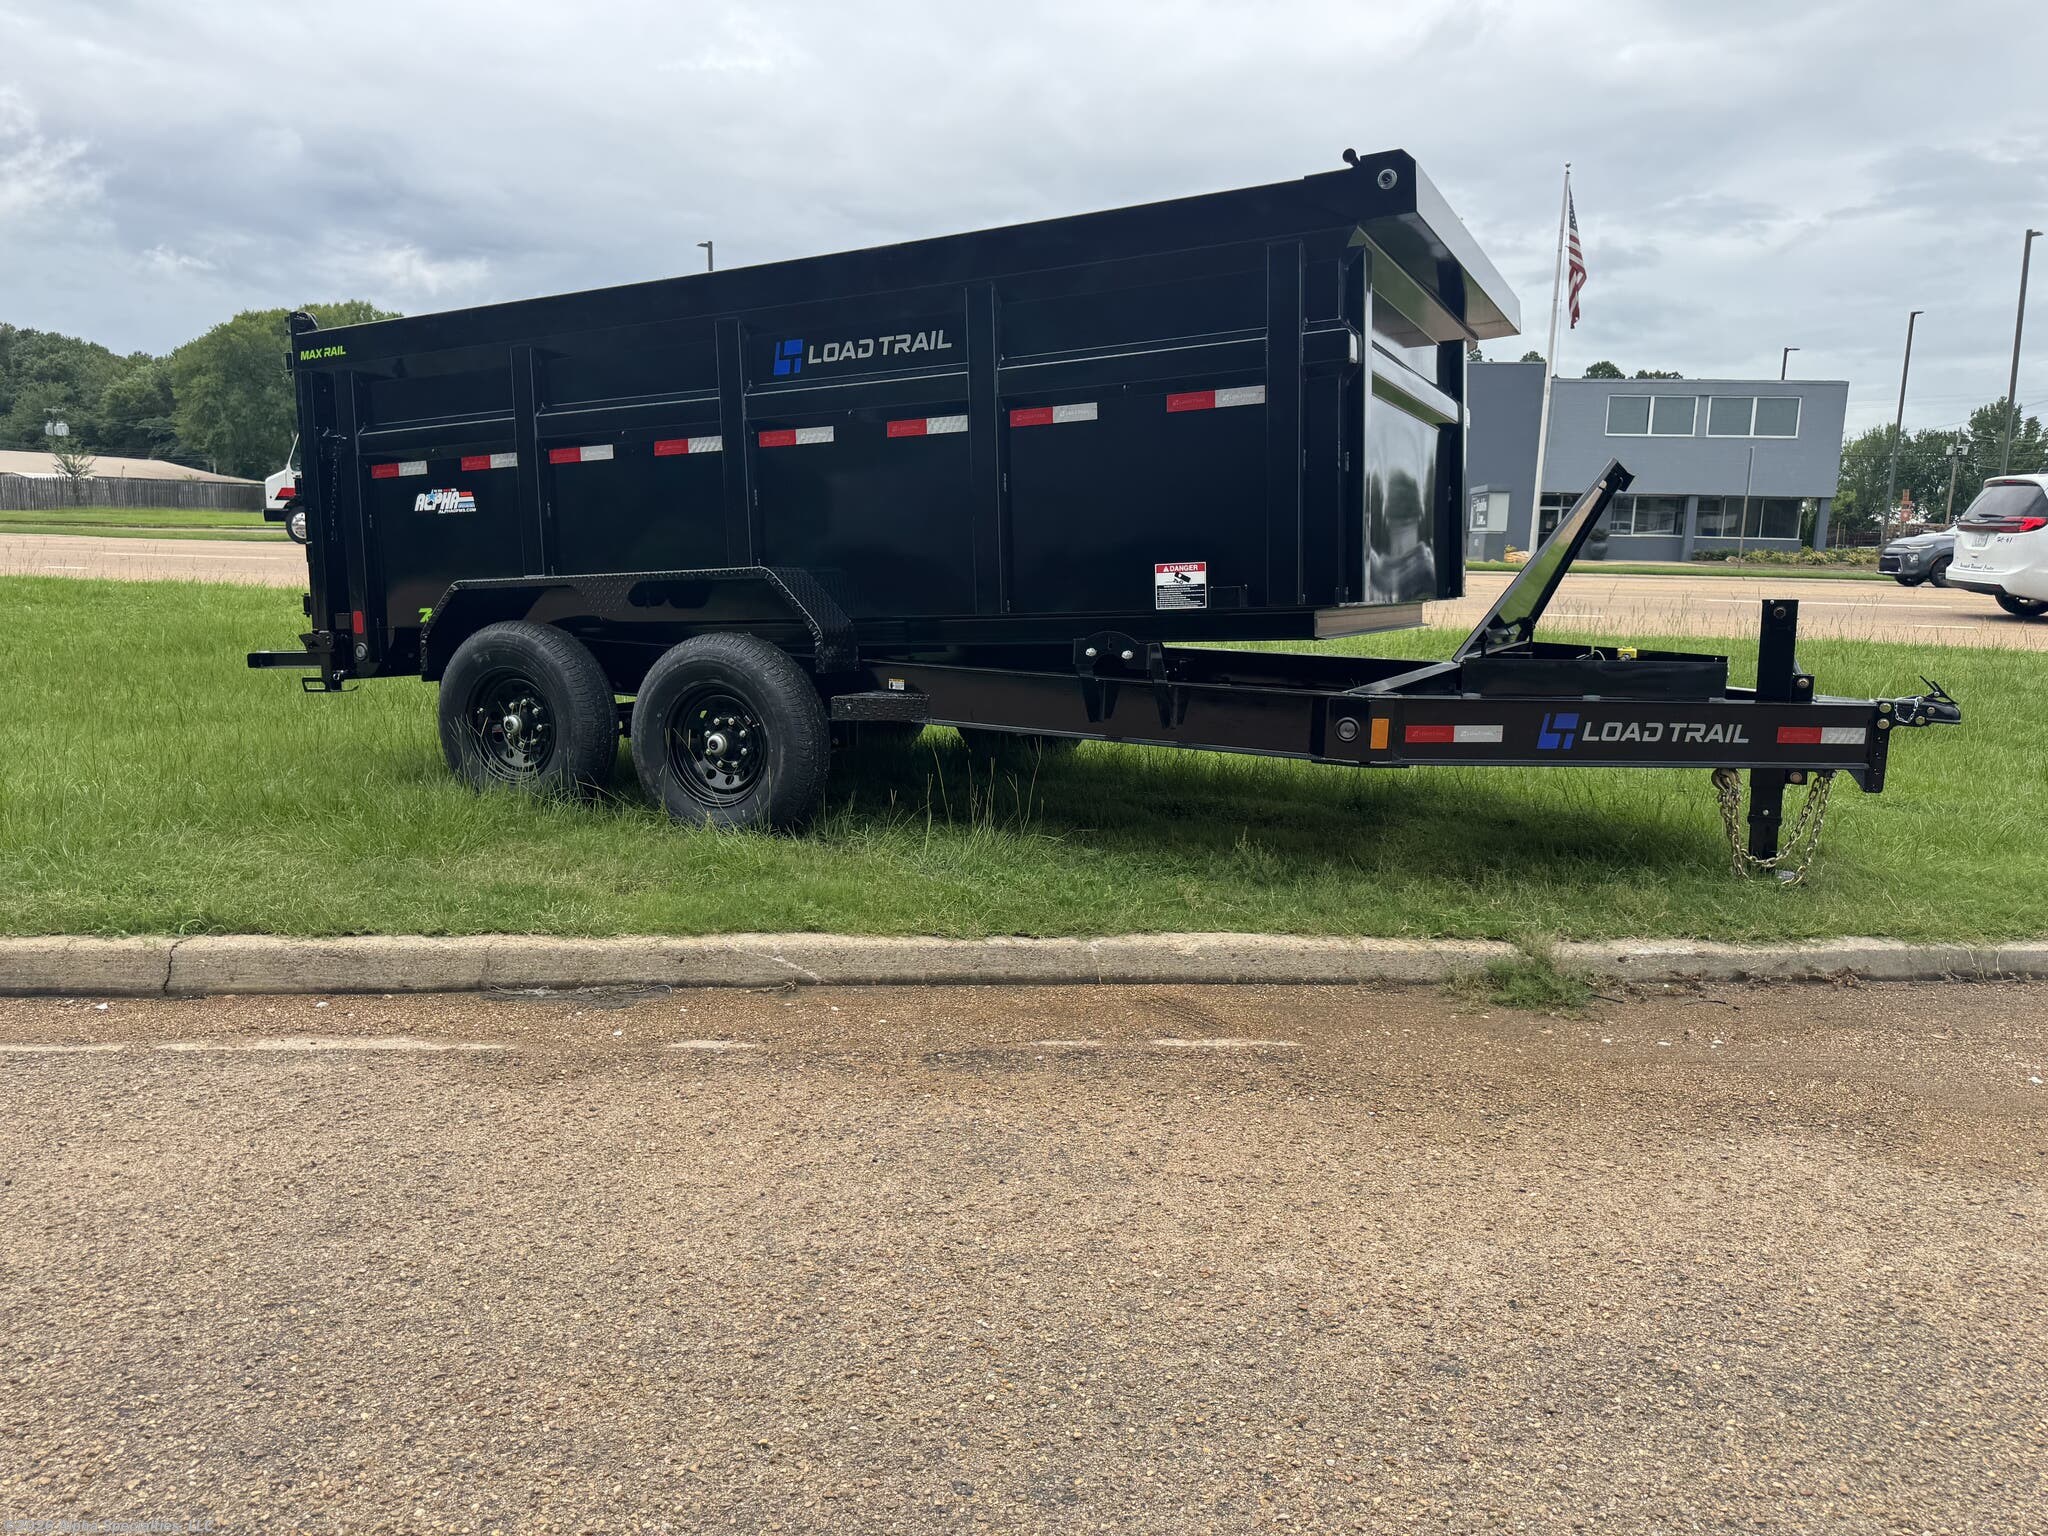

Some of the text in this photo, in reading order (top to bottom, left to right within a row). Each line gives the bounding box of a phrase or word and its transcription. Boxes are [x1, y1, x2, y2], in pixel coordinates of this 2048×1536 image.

[300, 345, 347, 360] MAX RAIL
[807, 329, 953, 364] LOAD TRAIL
[414, 490, 460, 512] ALPHA
[1169, 564, 1199, 572] DANGER
[1581, 721, 1750, 744] LOAD TRAIL
